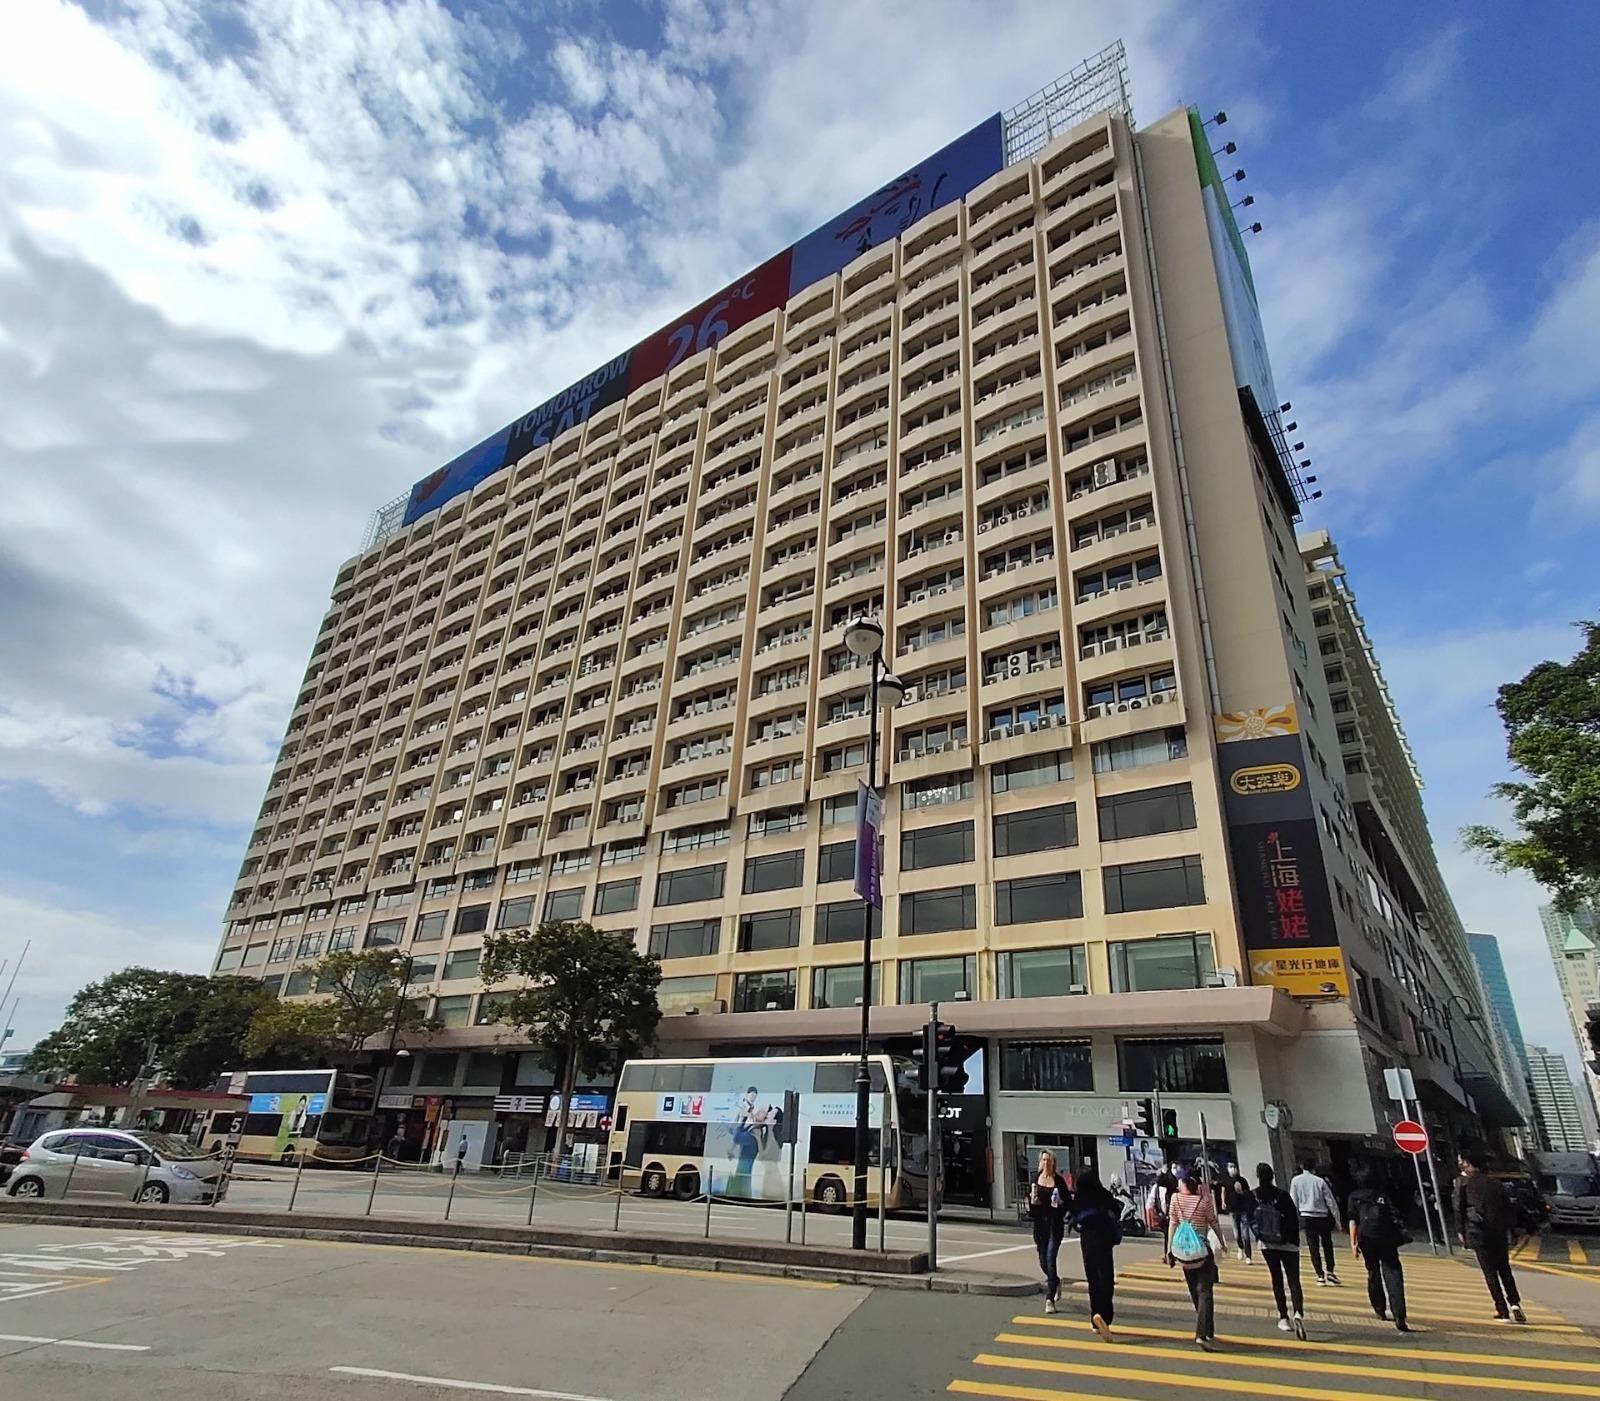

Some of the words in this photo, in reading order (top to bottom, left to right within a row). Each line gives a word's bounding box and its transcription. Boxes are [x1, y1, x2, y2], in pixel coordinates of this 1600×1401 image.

[515, 351, 631, 438] TOMORROW
[533, 392, 600, 446] SAT
[230, 1117, 242, 1132] 5
